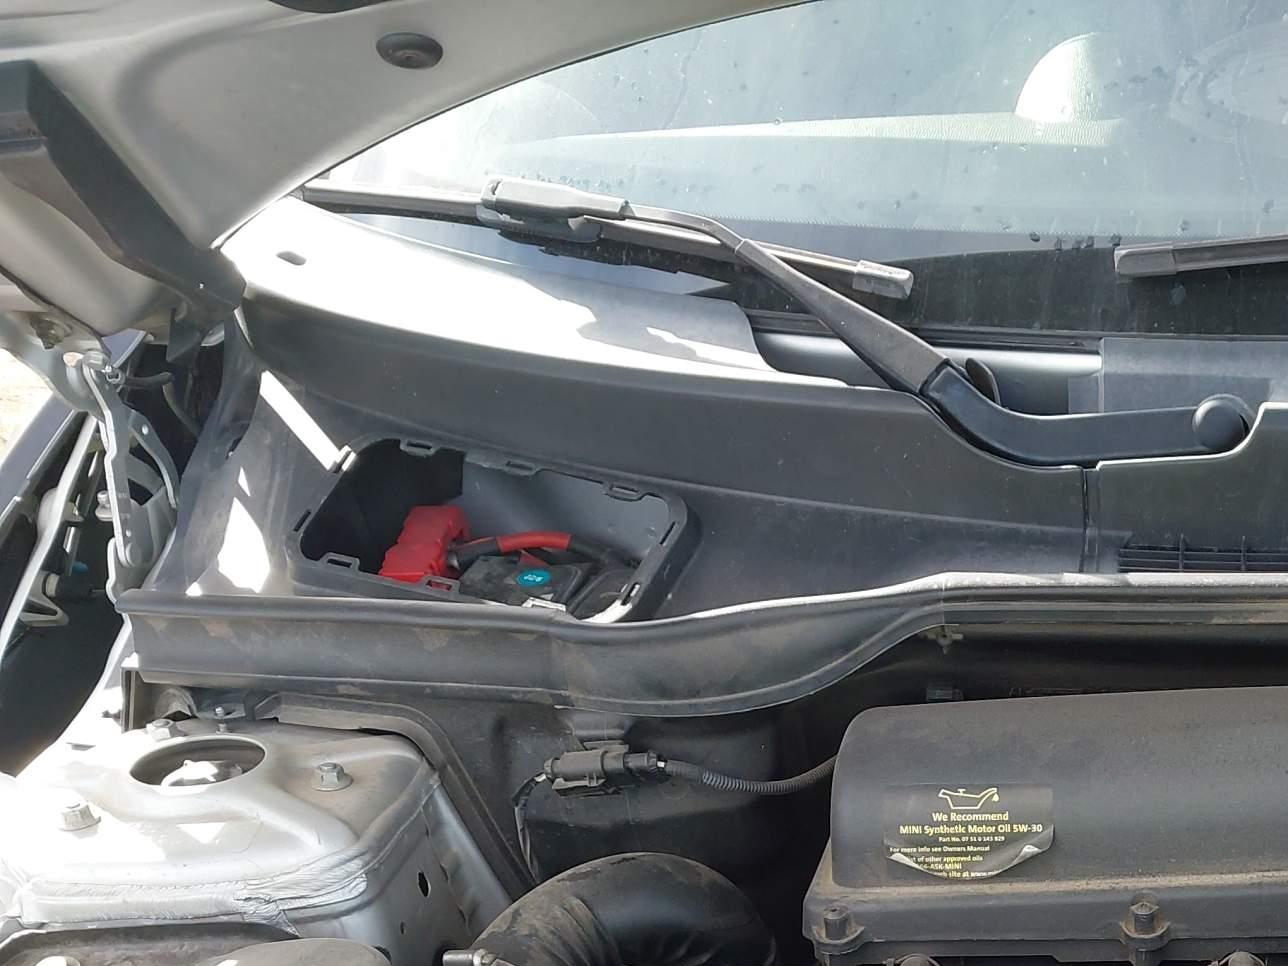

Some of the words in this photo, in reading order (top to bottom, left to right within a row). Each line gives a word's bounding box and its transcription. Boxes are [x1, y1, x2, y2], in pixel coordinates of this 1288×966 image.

[932, 812, 948, 822] We
[950, 811, 1009, 822] Recommend
[899, 825, 922, 834] MINI
[924, 824, 966, 836] Synthetic
[968, 825, 996, 833] Motor
[997, 824, 1011, 833] Oil
[1012, 824, 1043, 833] 5W-30
